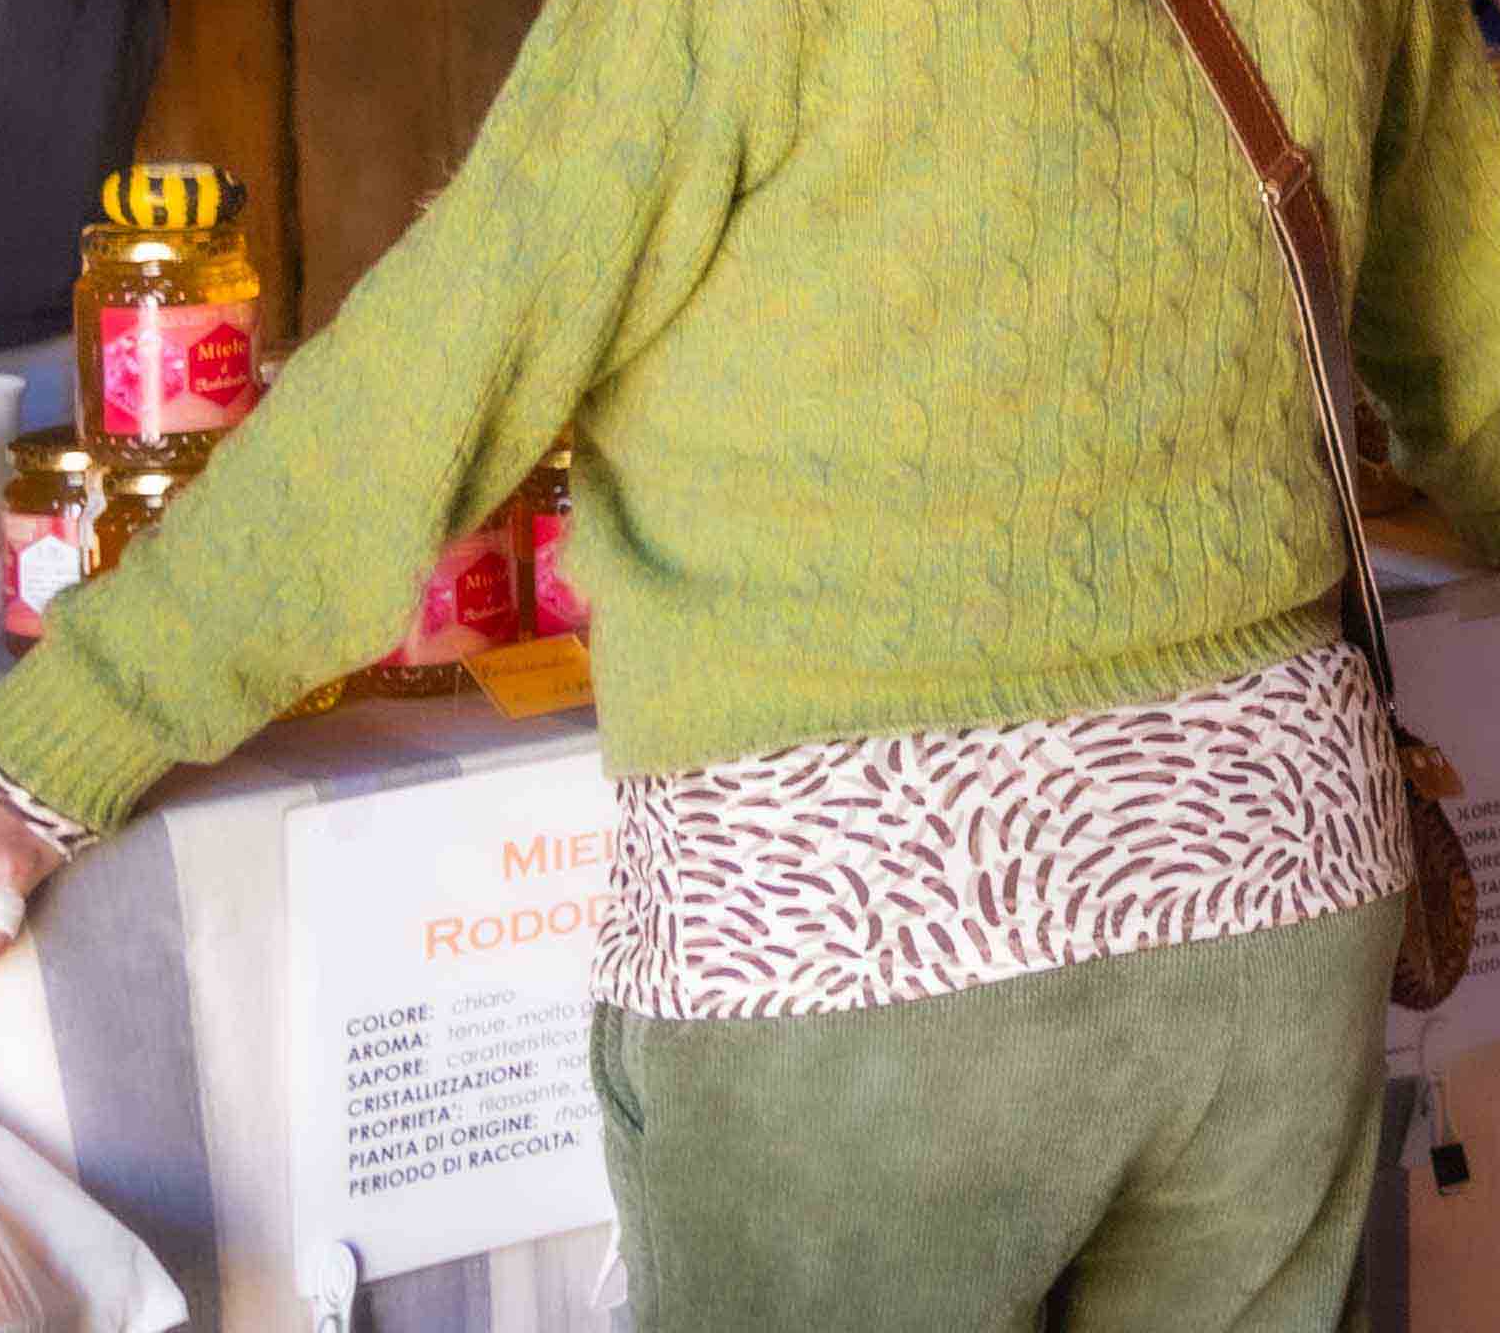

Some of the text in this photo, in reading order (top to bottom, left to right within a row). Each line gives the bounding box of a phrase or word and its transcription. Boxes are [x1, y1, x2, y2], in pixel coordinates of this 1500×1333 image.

[346, 988, 518, 1038] COLORE: chiaro
[347, 1032, 431, 1064] AROMA:
[347, 1057, 431, 1092] SAPORE:
[348, 1060, 540, 1118] CRISTALLIZZAZIONE:
[349, 1139, 419, 1172] PIANTA
[425, 1133, 444, 1154] DI
[450, 1113, 539, 1148] ORIGINE:
[349, 1129, 580, 1200] PERIODO DI RACCOLTA:
